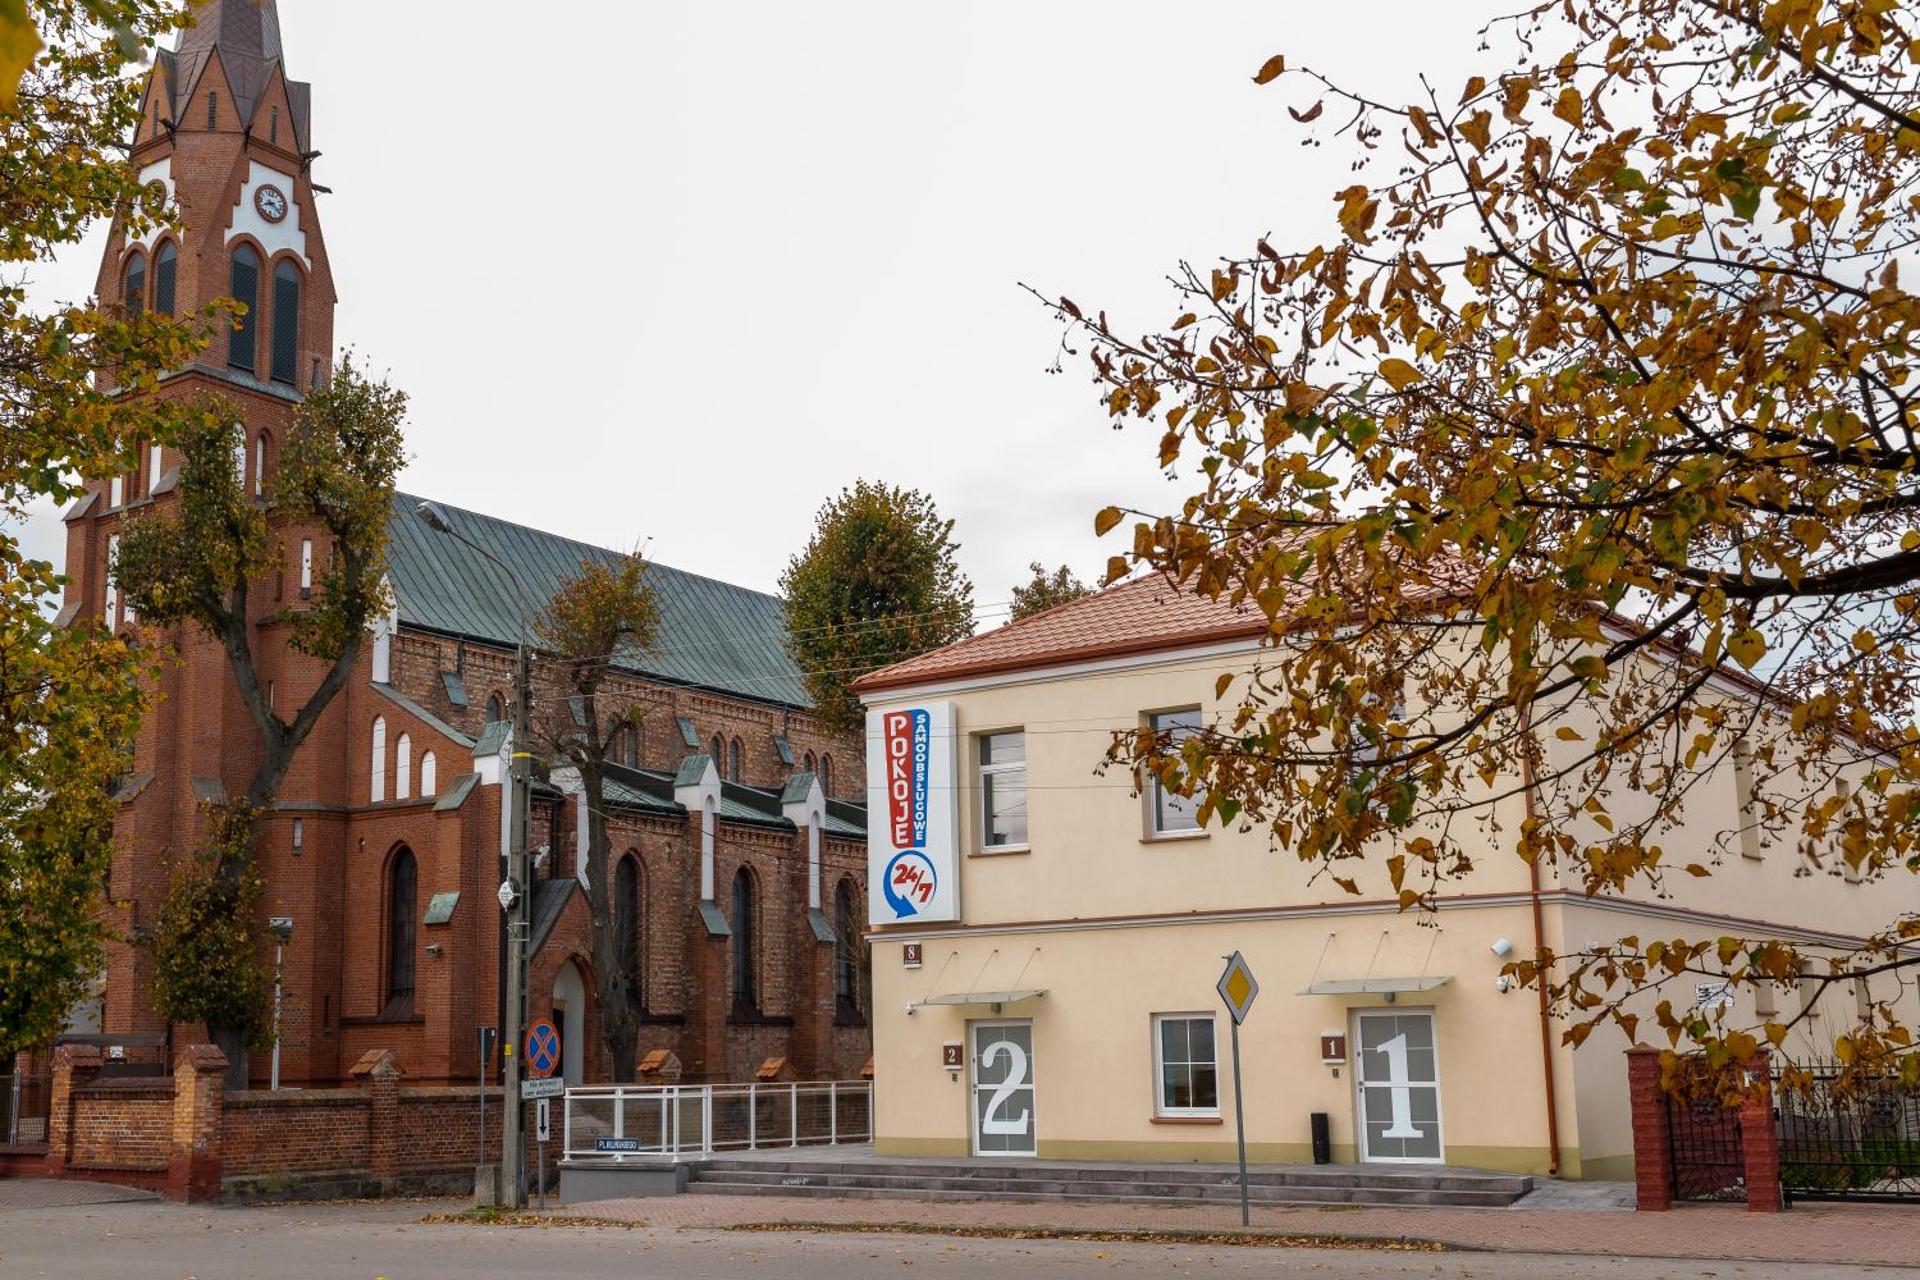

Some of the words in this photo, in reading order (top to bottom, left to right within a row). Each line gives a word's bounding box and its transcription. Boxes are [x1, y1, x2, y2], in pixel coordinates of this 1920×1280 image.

[890, 716, 909, 845] POKOJE
[914, 714, 926, 840] SAMOOBSŁUGOWE
[893, 863, 933, 903] 24/7
[908, 945, 915, 960] 8
[948, 1048, 956, 1063] 2
[1328, 1040, 1336, 1056] 1
[982, 1041, 1029, 1134] 2
[1376, 1032, 1424, 1138] 1
